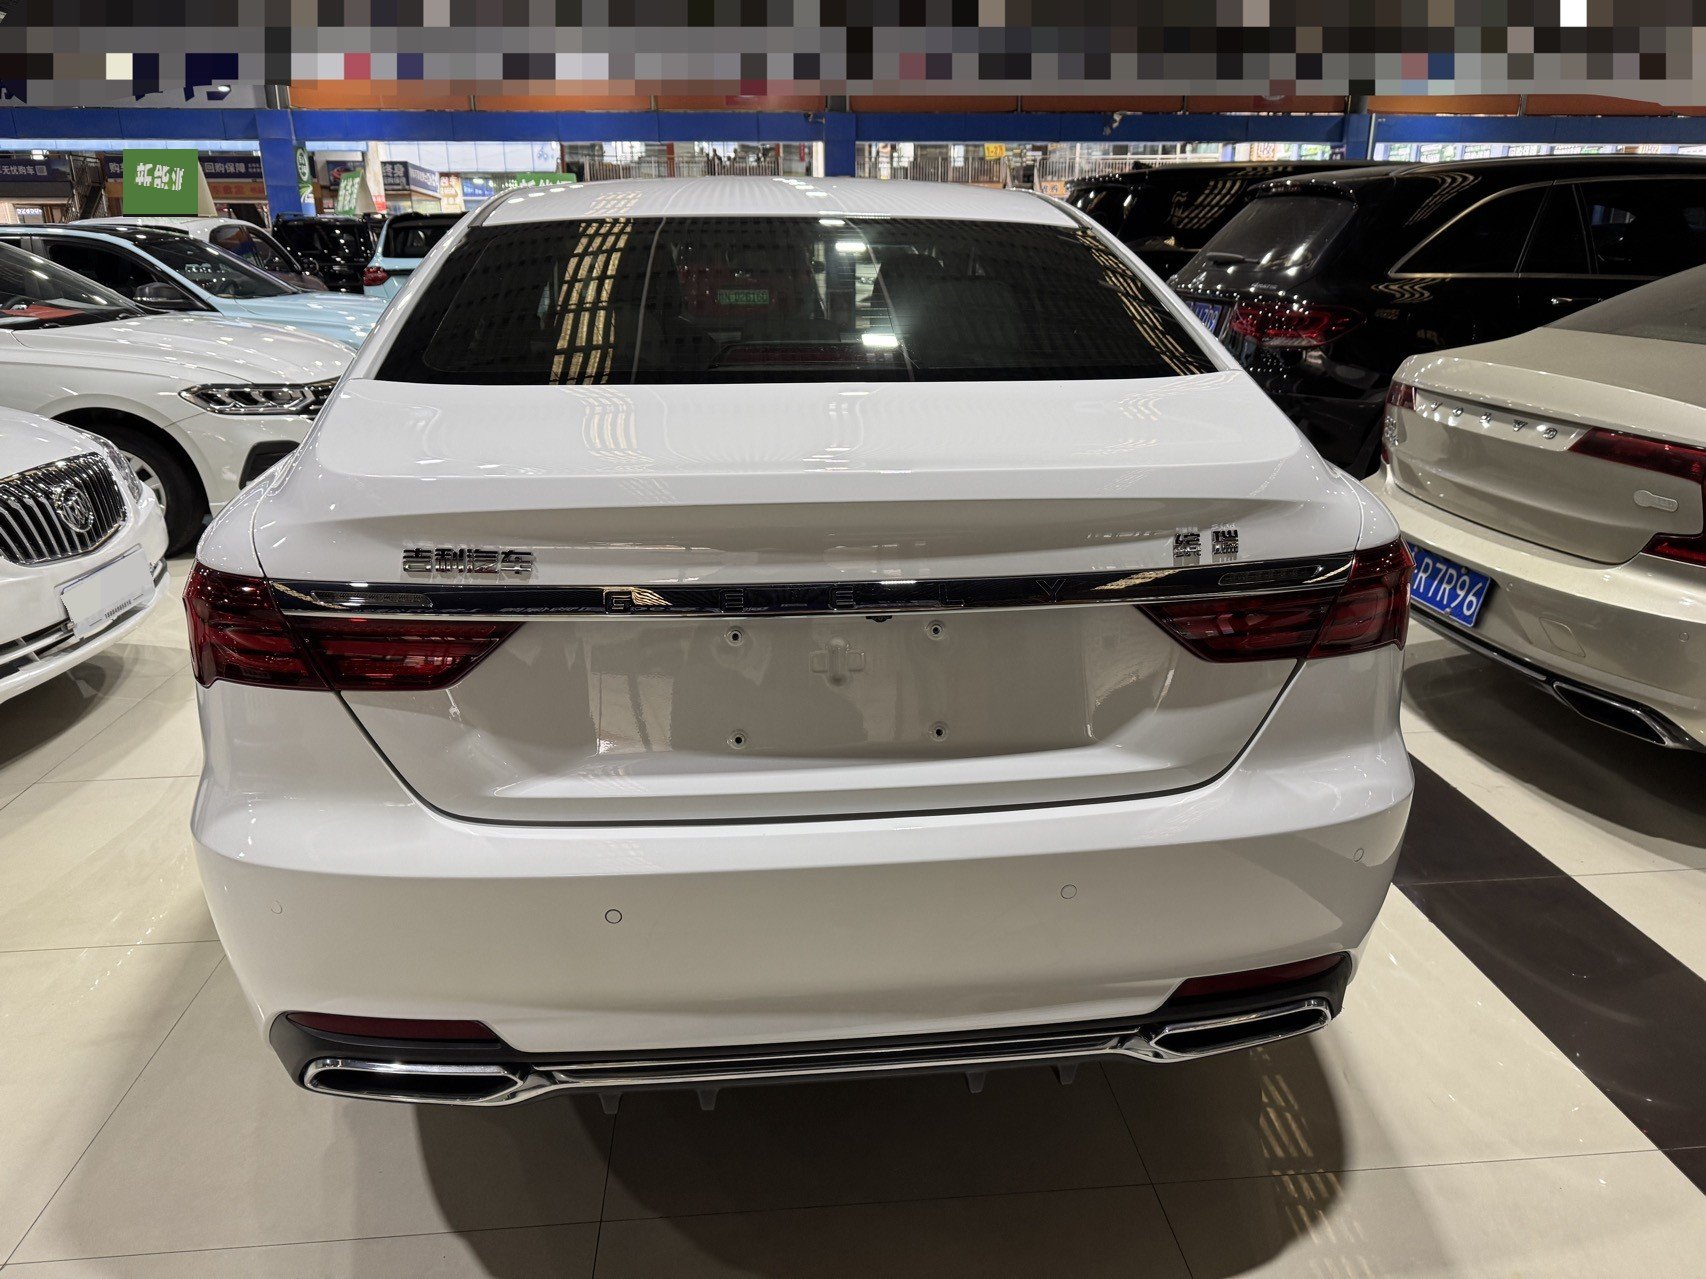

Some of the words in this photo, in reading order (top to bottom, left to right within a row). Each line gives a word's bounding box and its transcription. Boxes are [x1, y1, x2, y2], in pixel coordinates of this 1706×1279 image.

[0, 165, 35, 175] 无忧购车
[402, 548, 533, 574] 吉利汽车
[604, 578, 1067, 614] GEELY
